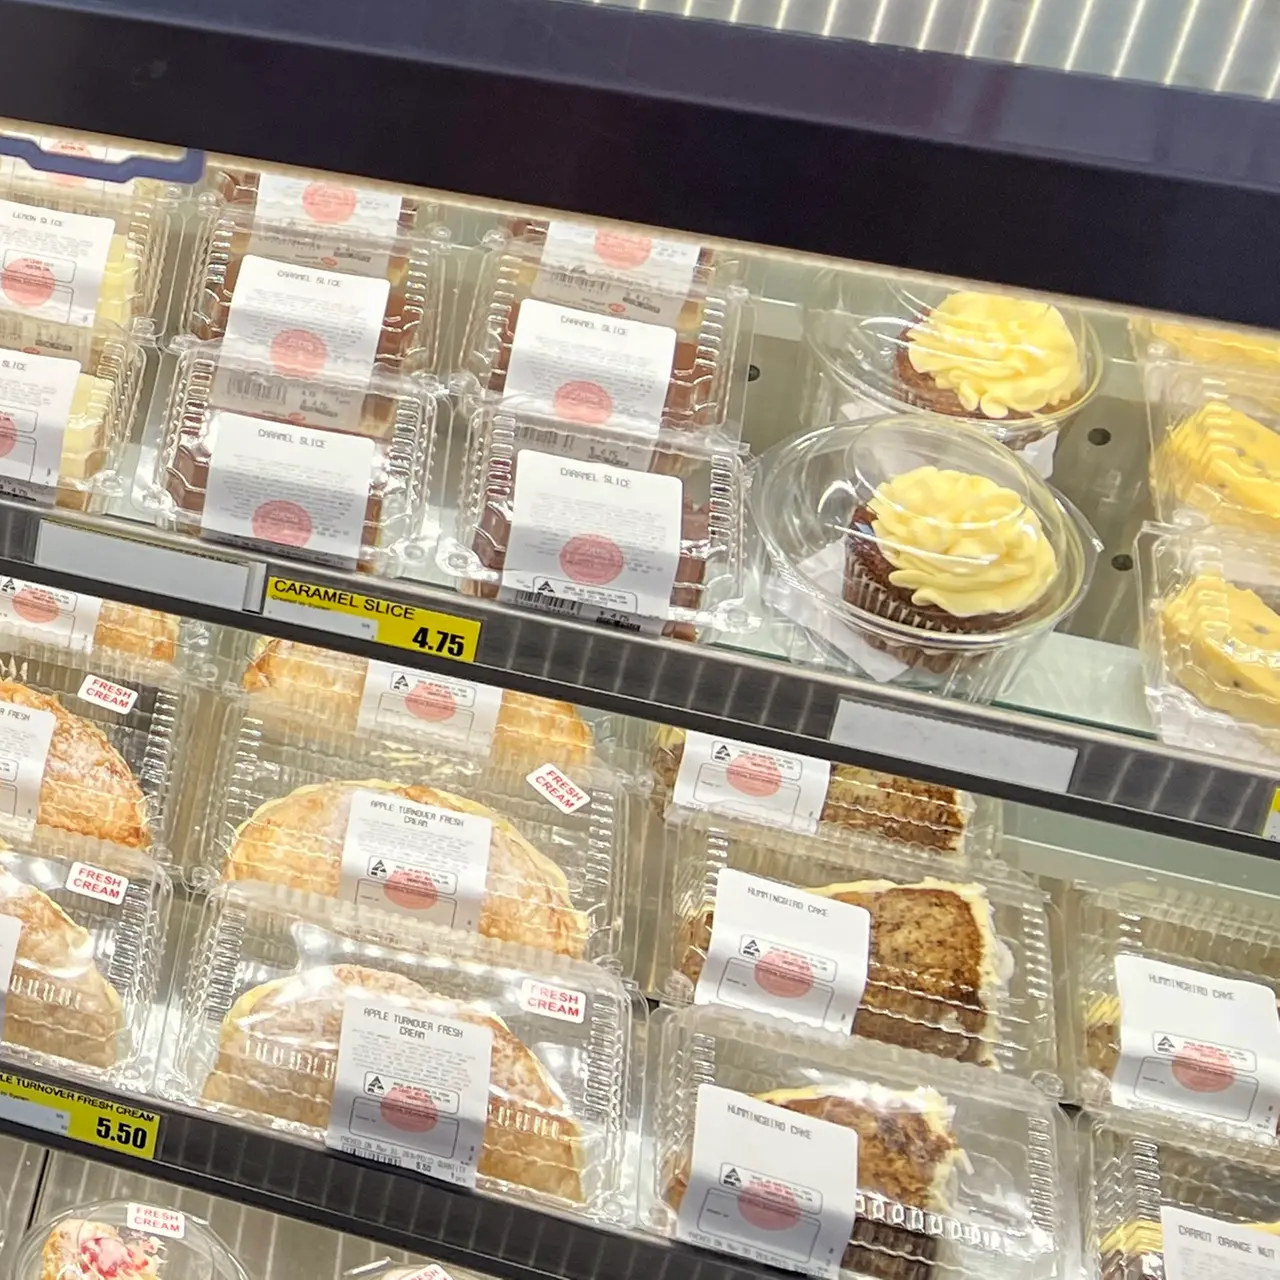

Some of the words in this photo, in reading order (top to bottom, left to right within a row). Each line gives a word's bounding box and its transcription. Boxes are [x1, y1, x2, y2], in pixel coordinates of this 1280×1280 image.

[560, 467, 598, 482] CARAMEL
[604, 474, 630, 488] SLICE
[274, 579, 359, 608] CARAMEL
[363, 598, 416, 620] SLICE
[412, 626, 465, 658] 4.75
[86, 687, 129, 708] CREAM
[92, 678, 132, 699] FRESH
[535, 776, 575, 808] CREAM
[546, 770, 584, 801] FRESH
[73, 878, 120, 899] CREAM
[78, 868, 122, 887] FRESH
[363, 1007, 389, 1021] APPLE
[393, 1014, 434, 1032] TURNOVER
[437, 1024, 464, 1038] FRESH
[400, 1026, 425, 1041] CREAM
[15, 1078, 75, 1101] TURNOVER
[77, 1095, 114, 1111] FRESH
[116, 1104, 155, 1122] CREAM
[96, 1116, 147, 1150] 5.50
[133, 1216, 180, 1232] CREAM
[135, 1207, 178, 1221] FRESH
[1178, 1224, 1212, 1242] CARROT
[1217, 1235, 1252, 1253] ORANGE
